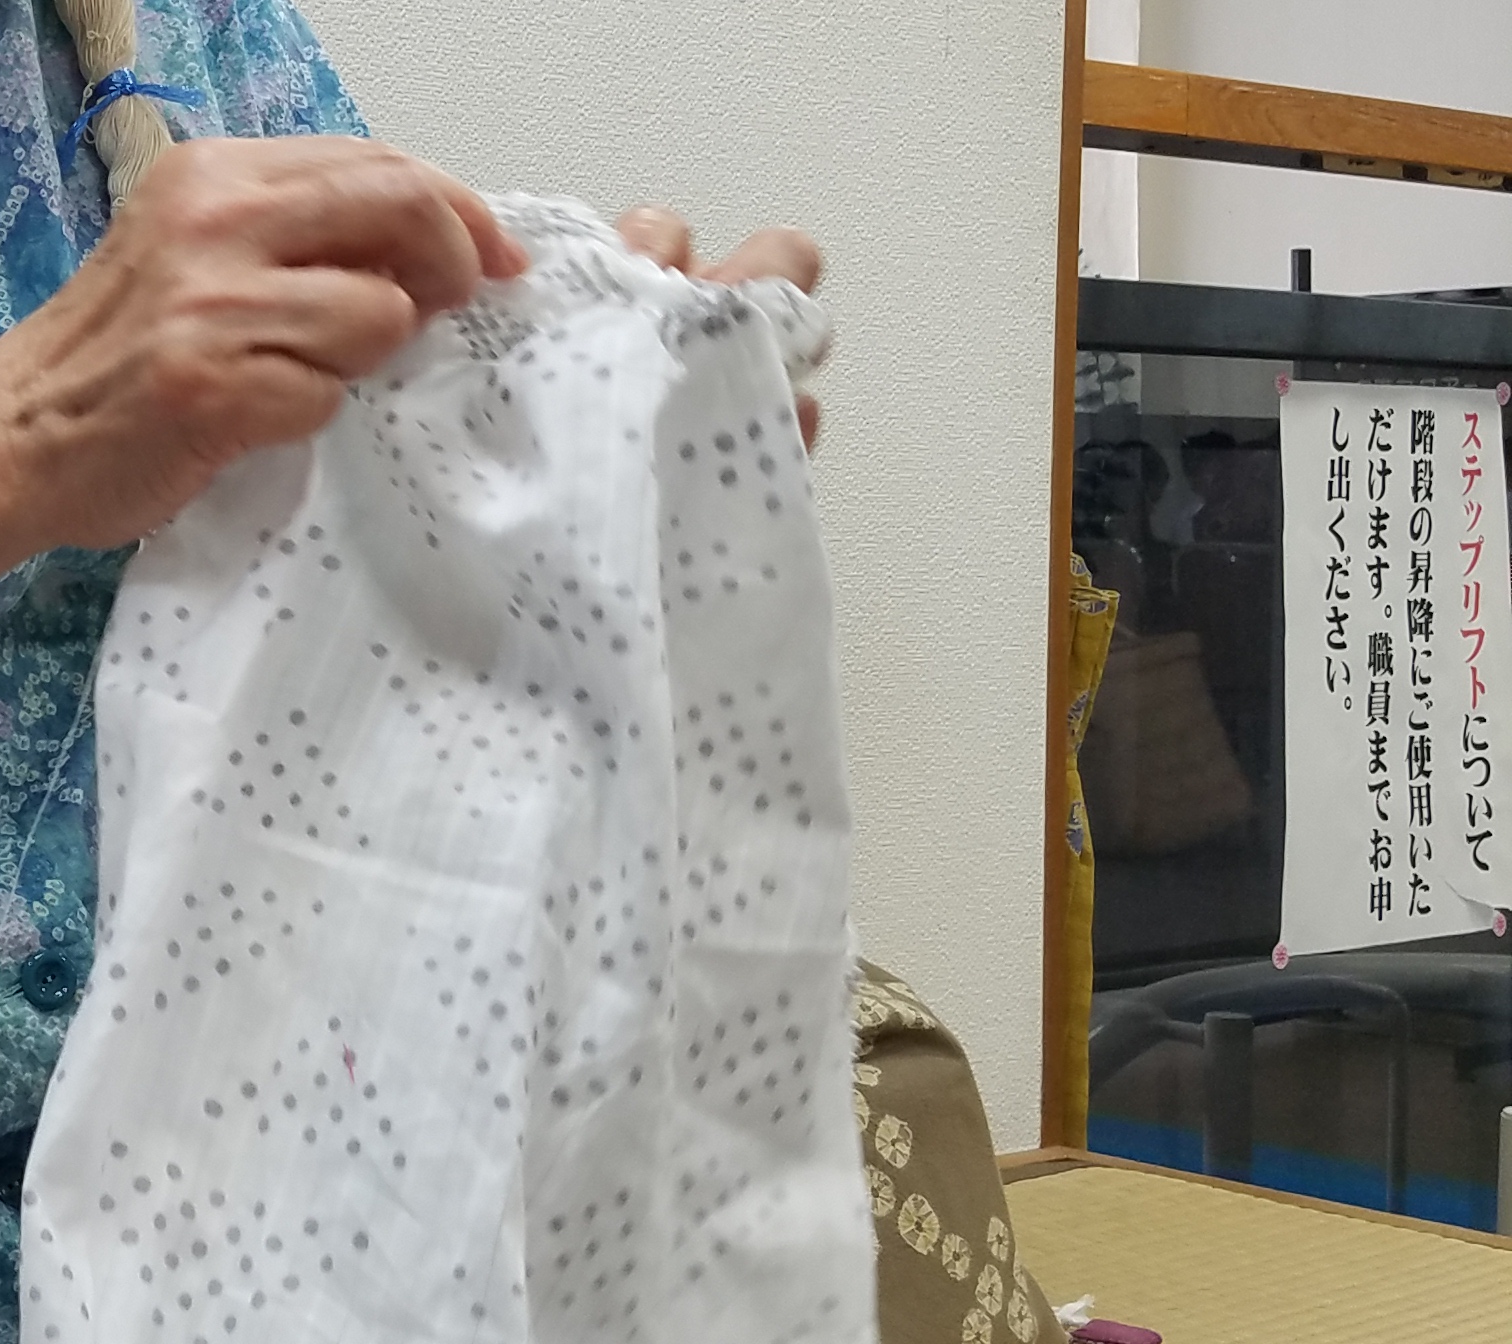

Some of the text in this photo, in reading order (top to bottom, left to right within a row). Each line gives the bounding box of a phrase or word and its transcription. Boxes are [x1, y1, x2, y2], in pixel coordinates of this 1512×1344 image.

[1325, 407, 1352, 712] し出ください。
[1365, 408, 1395, 922] だけます。職員までお申
[1405, 410, 1436, 918] 階段の昇降にご使用いた
[1459, 412, 1492, 872] ステップリフトについて
